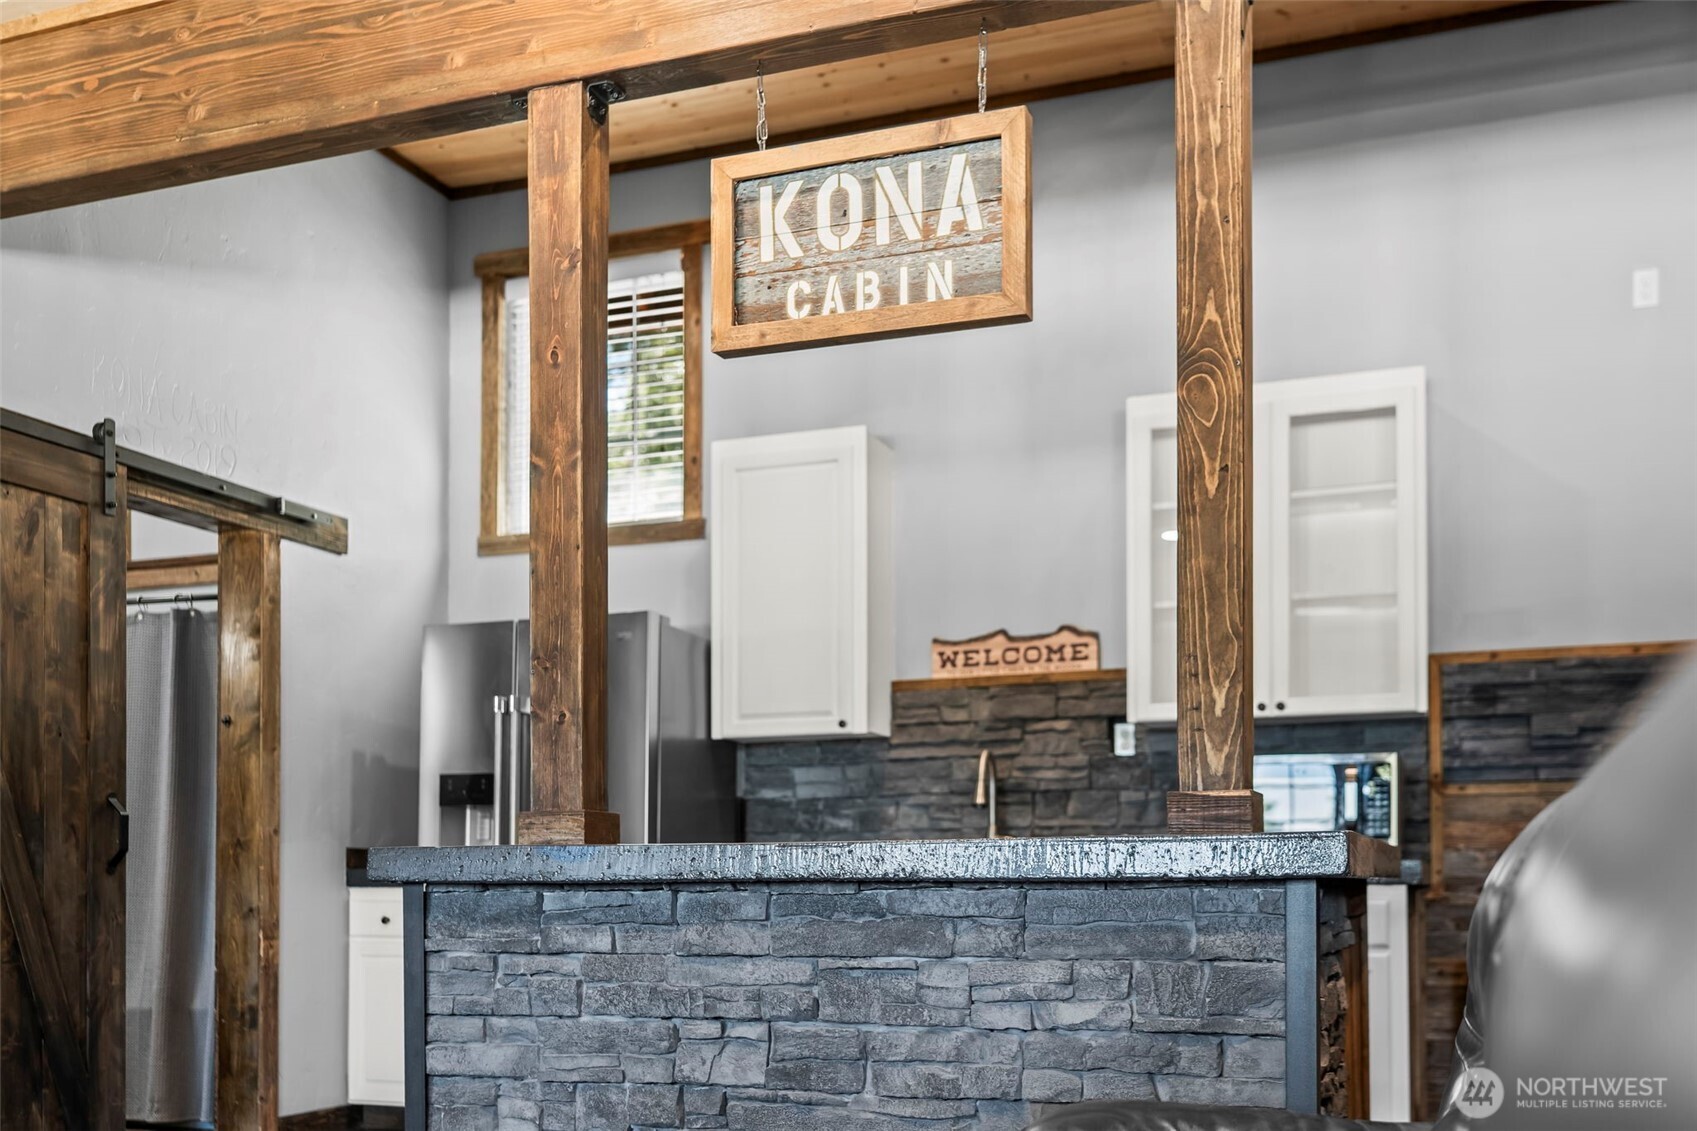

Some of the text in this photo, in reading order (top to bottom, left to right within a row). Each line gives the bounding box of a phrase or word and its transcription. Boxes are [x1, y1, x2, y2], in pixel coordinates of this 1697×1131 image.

[759, 153, 984, 263] KONA
[786, 260, 953, 320] CABIN
[171, 383, 239, 440] CABIN
[180, 436, 238, 478] 2019
[938, 643, 1090, 669] WELCOME
